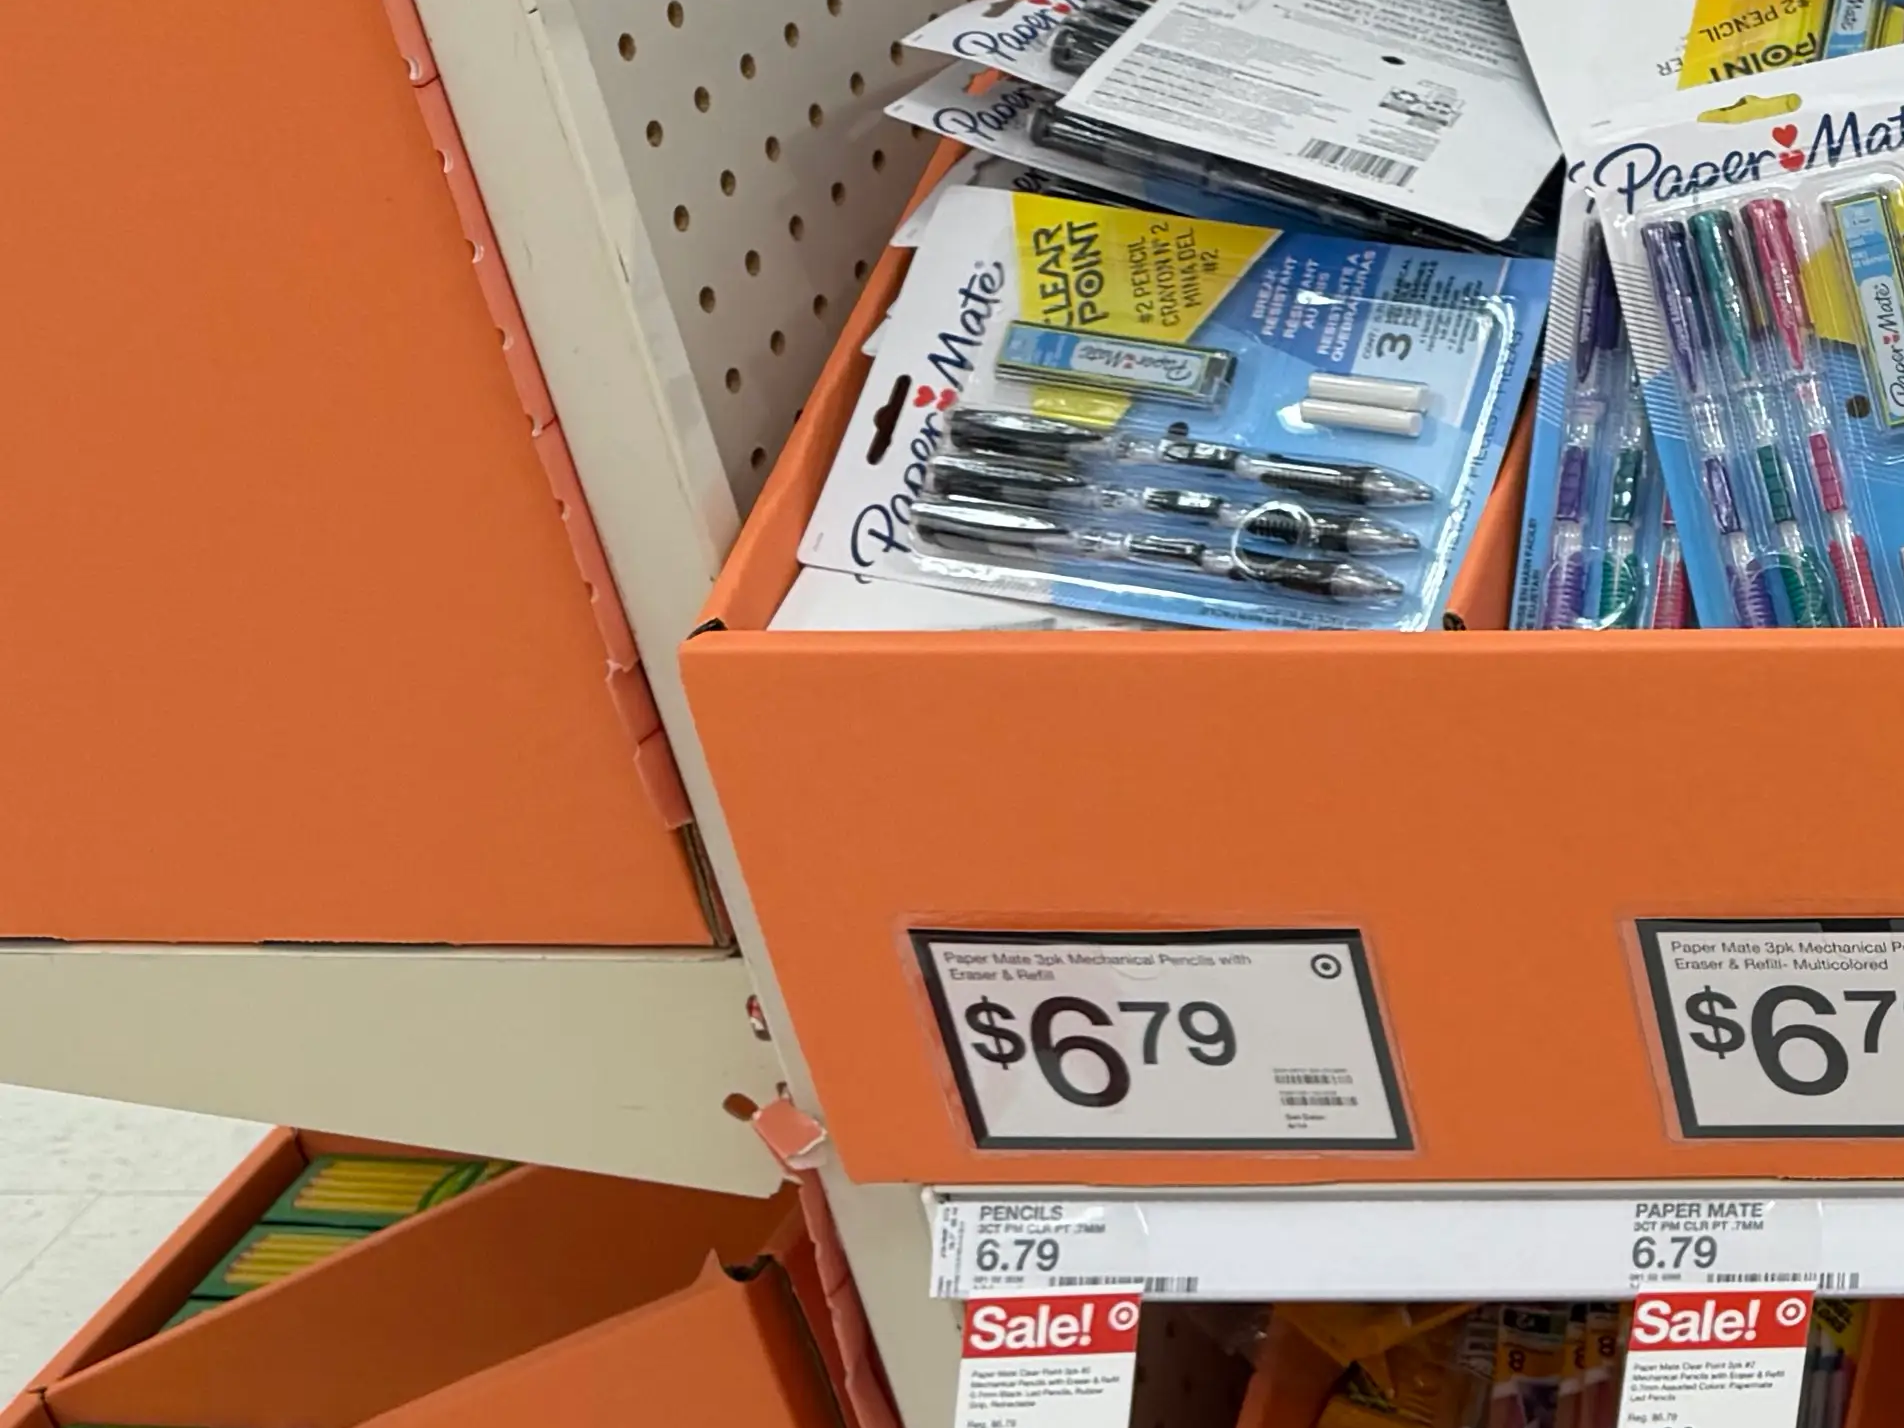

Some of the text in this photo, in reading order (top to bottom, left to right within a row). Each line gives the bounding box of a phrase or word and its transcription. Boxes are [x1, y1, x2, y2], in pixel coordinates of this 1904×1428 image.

[1594, 143, 1776, 215] Paper
[1635, 1201, 1764, 1219] PAPER MATE
[1632, 1235, 1718, 1270] 6.79
